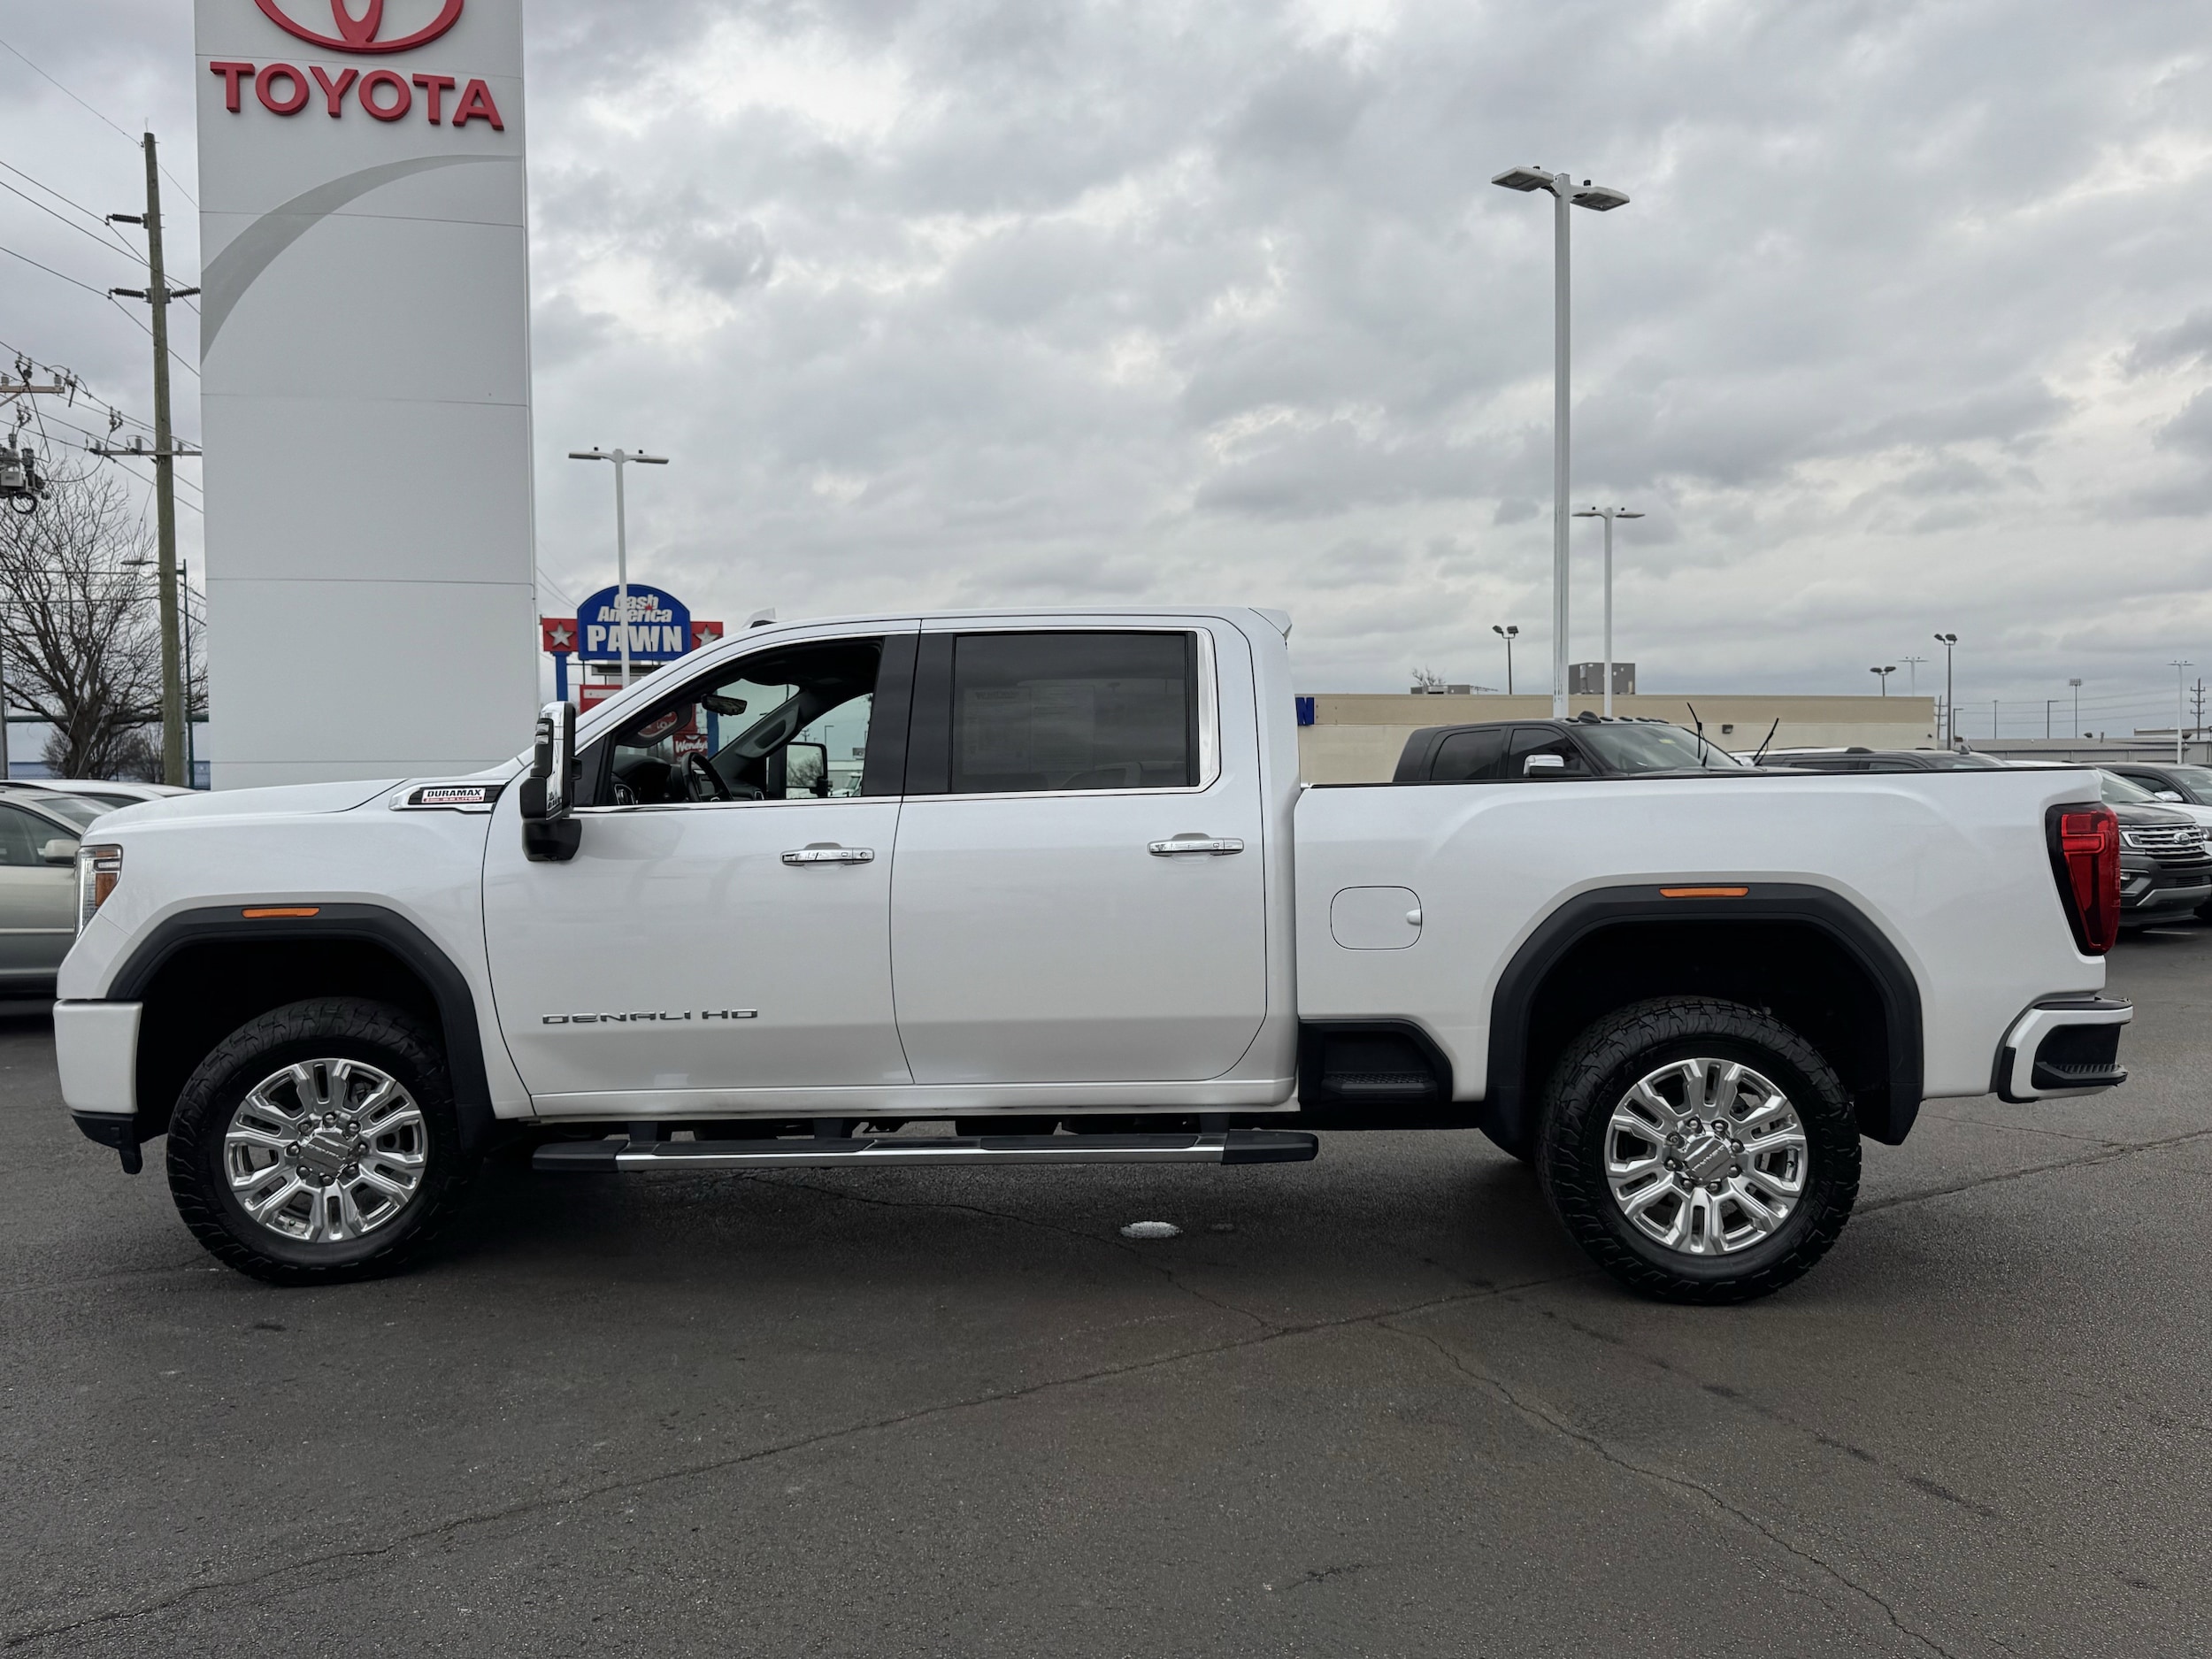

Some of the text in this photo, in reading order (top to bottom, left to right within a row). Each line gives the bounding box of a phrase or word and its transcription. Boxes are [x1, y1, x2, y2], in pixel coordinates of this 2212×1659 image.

[210, 61, 504, 131] TOYOTA
[596, 605, 672, 622] America
[587, 625, 683, 652] PAWN
[542, 1009, 758, 1024] DENALI HD
